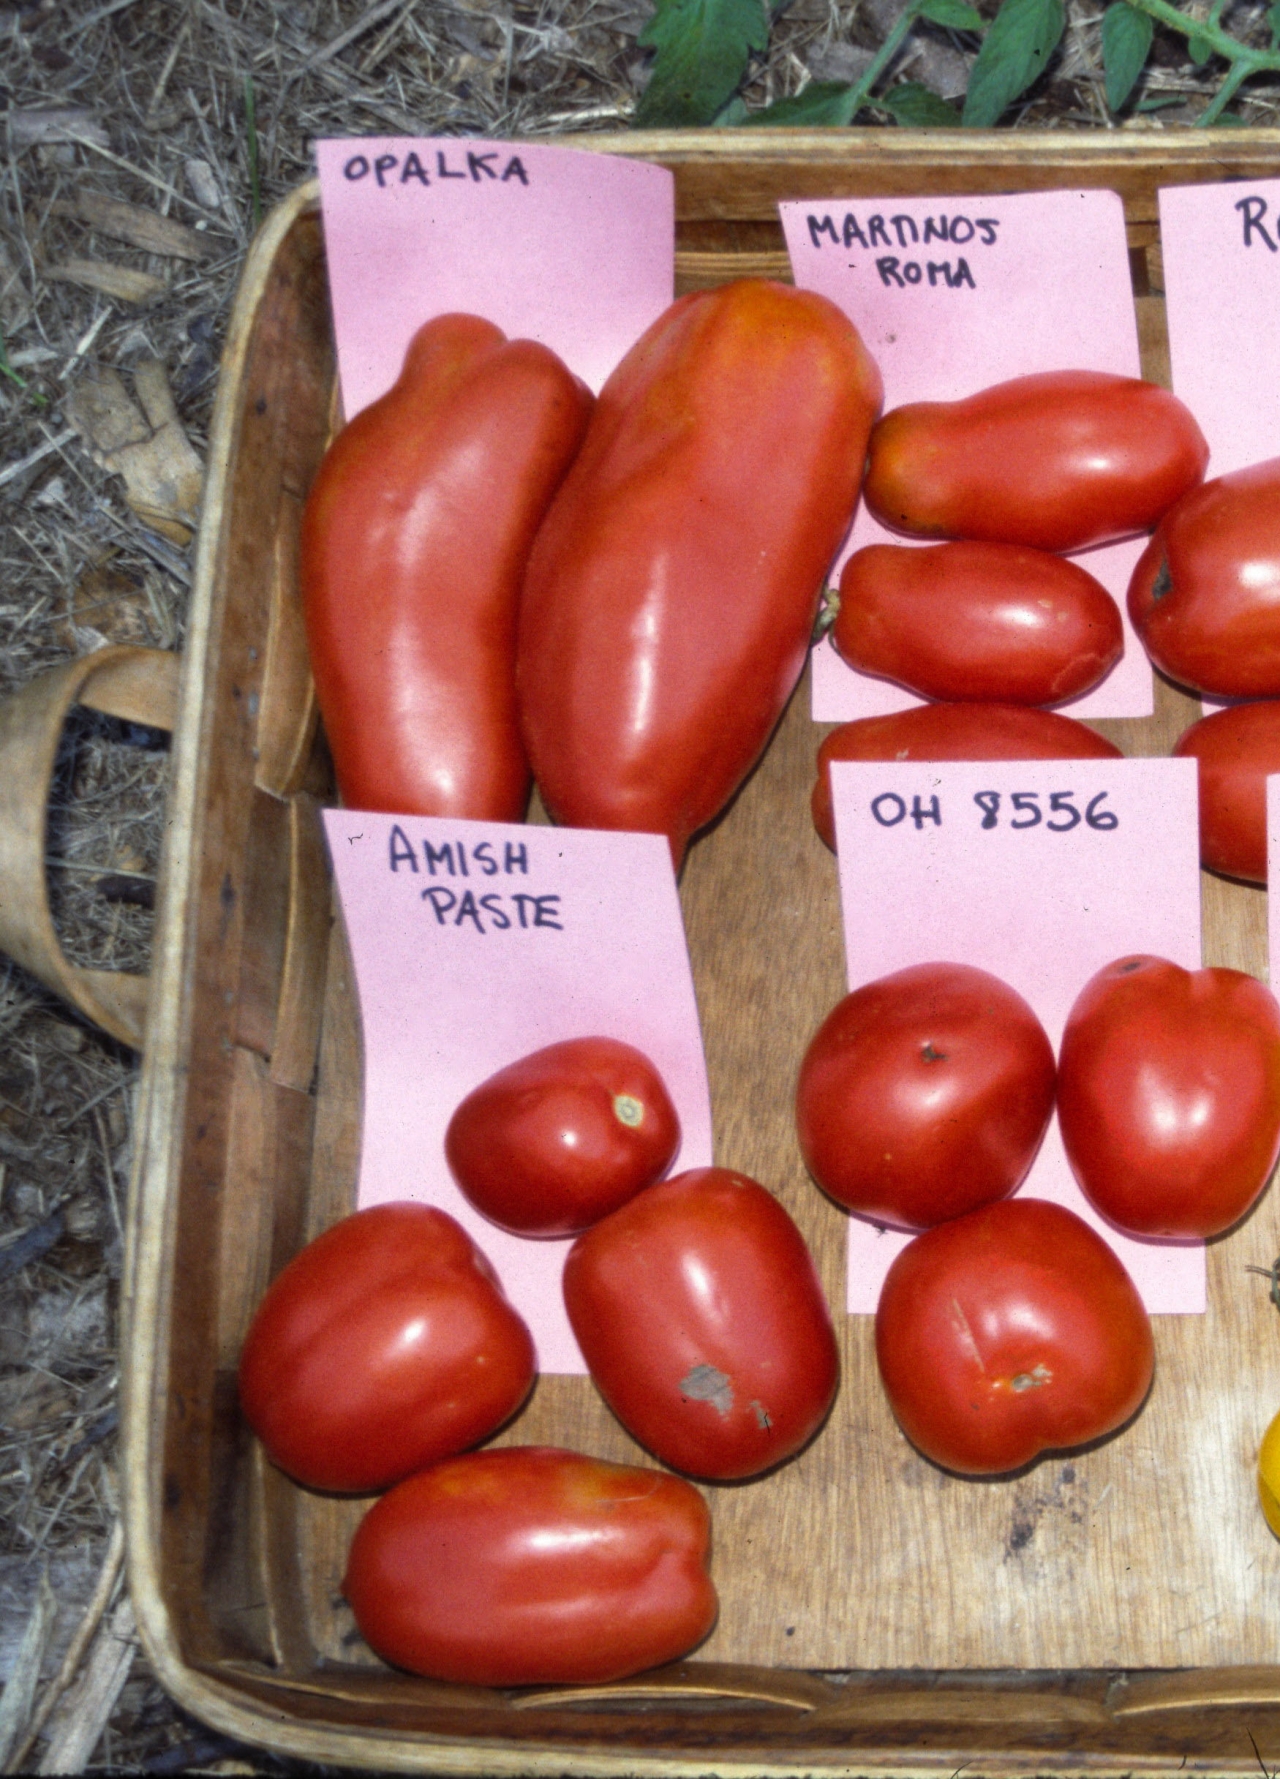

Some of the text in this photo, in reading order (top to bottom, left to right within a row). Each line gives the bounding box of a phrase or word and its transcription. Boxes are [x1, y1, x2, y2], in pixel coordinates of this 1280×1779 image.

[343, 151, 530, 187] OPALKA
[805, 213, 1000, 249] MARTINOS
[874, 255, 977, 289] ROMA
[870, 790, 1119, 832] OH 8556
[389, 824, 529, 877] AMISH
[421, 886, 563, 935] PASTE
